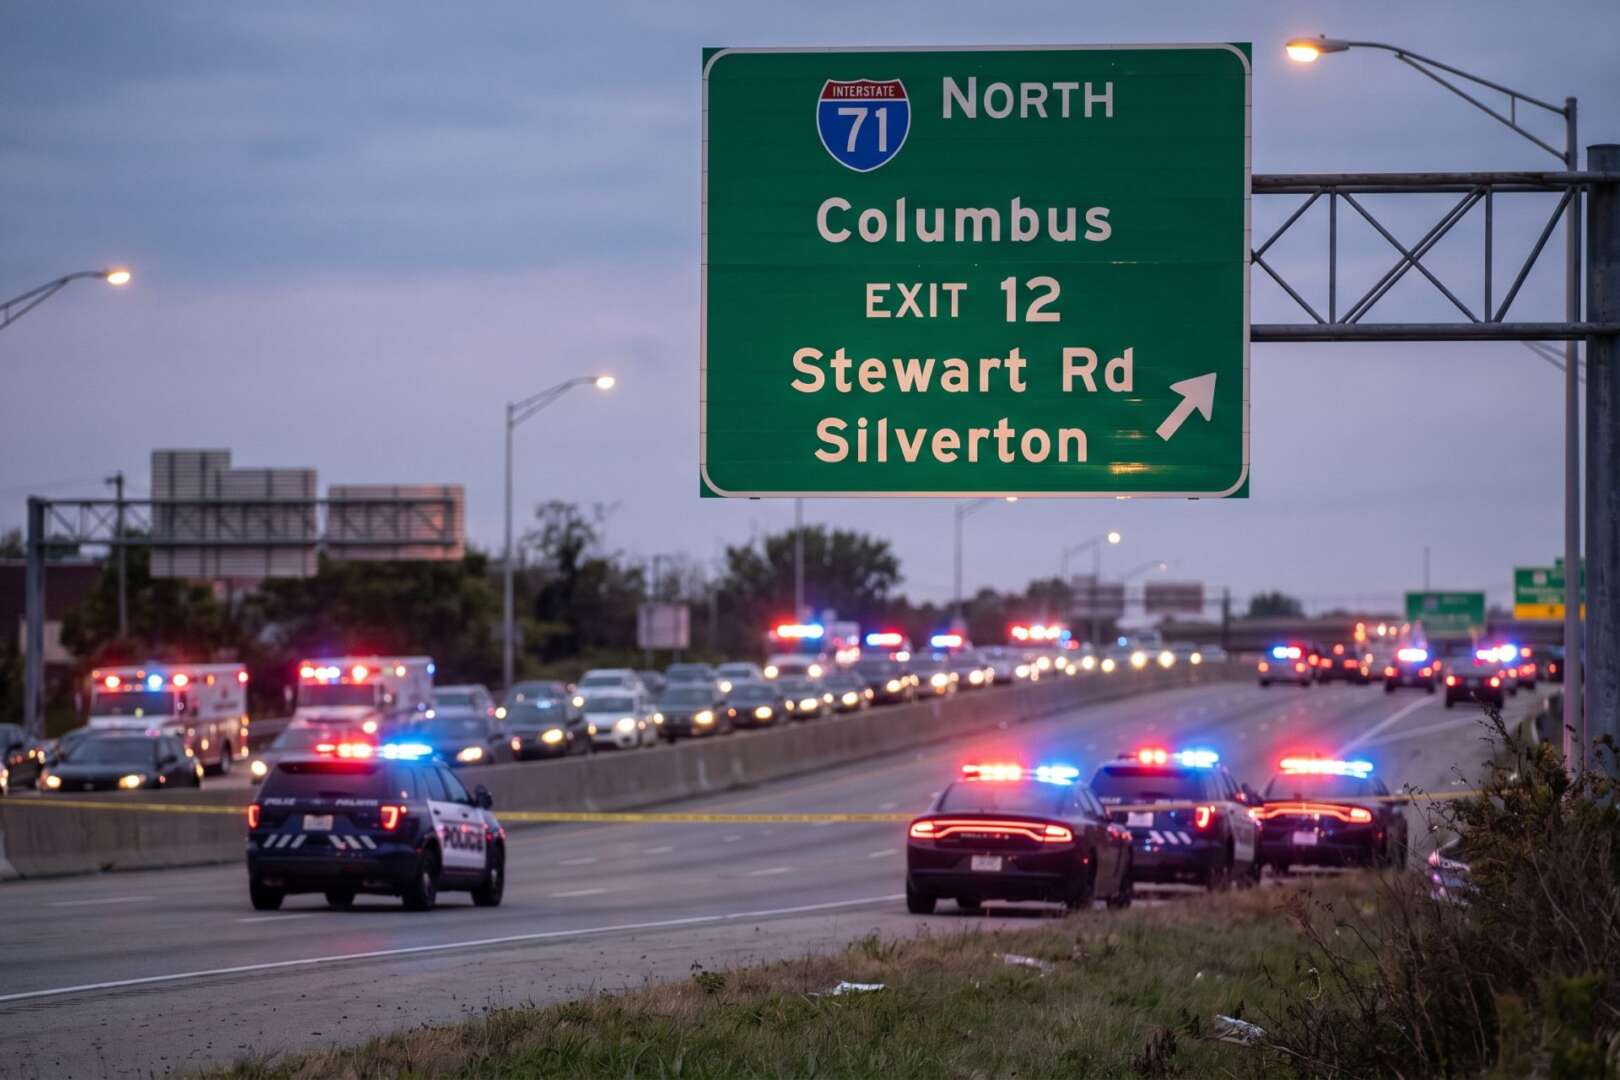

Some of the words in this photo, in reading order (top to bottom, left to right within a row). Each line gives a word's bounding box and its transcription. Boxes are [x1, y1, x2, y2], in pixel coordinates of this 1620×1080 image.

[832, 84, 896, 98] INTERSTATE
[942, 76, 1114, 119] NORTH
[837, 107, 888, 153] 71
[816, 196, 1113, 243] Columbus
[865, 282, 968, 318] EXIT
[1000, 276, 1062, 323] 12
[790, 347, 1027, 393] Stewart
[1061, 346, 1134, 393] Rd
[814, 416, 1088, 464] Silverton
